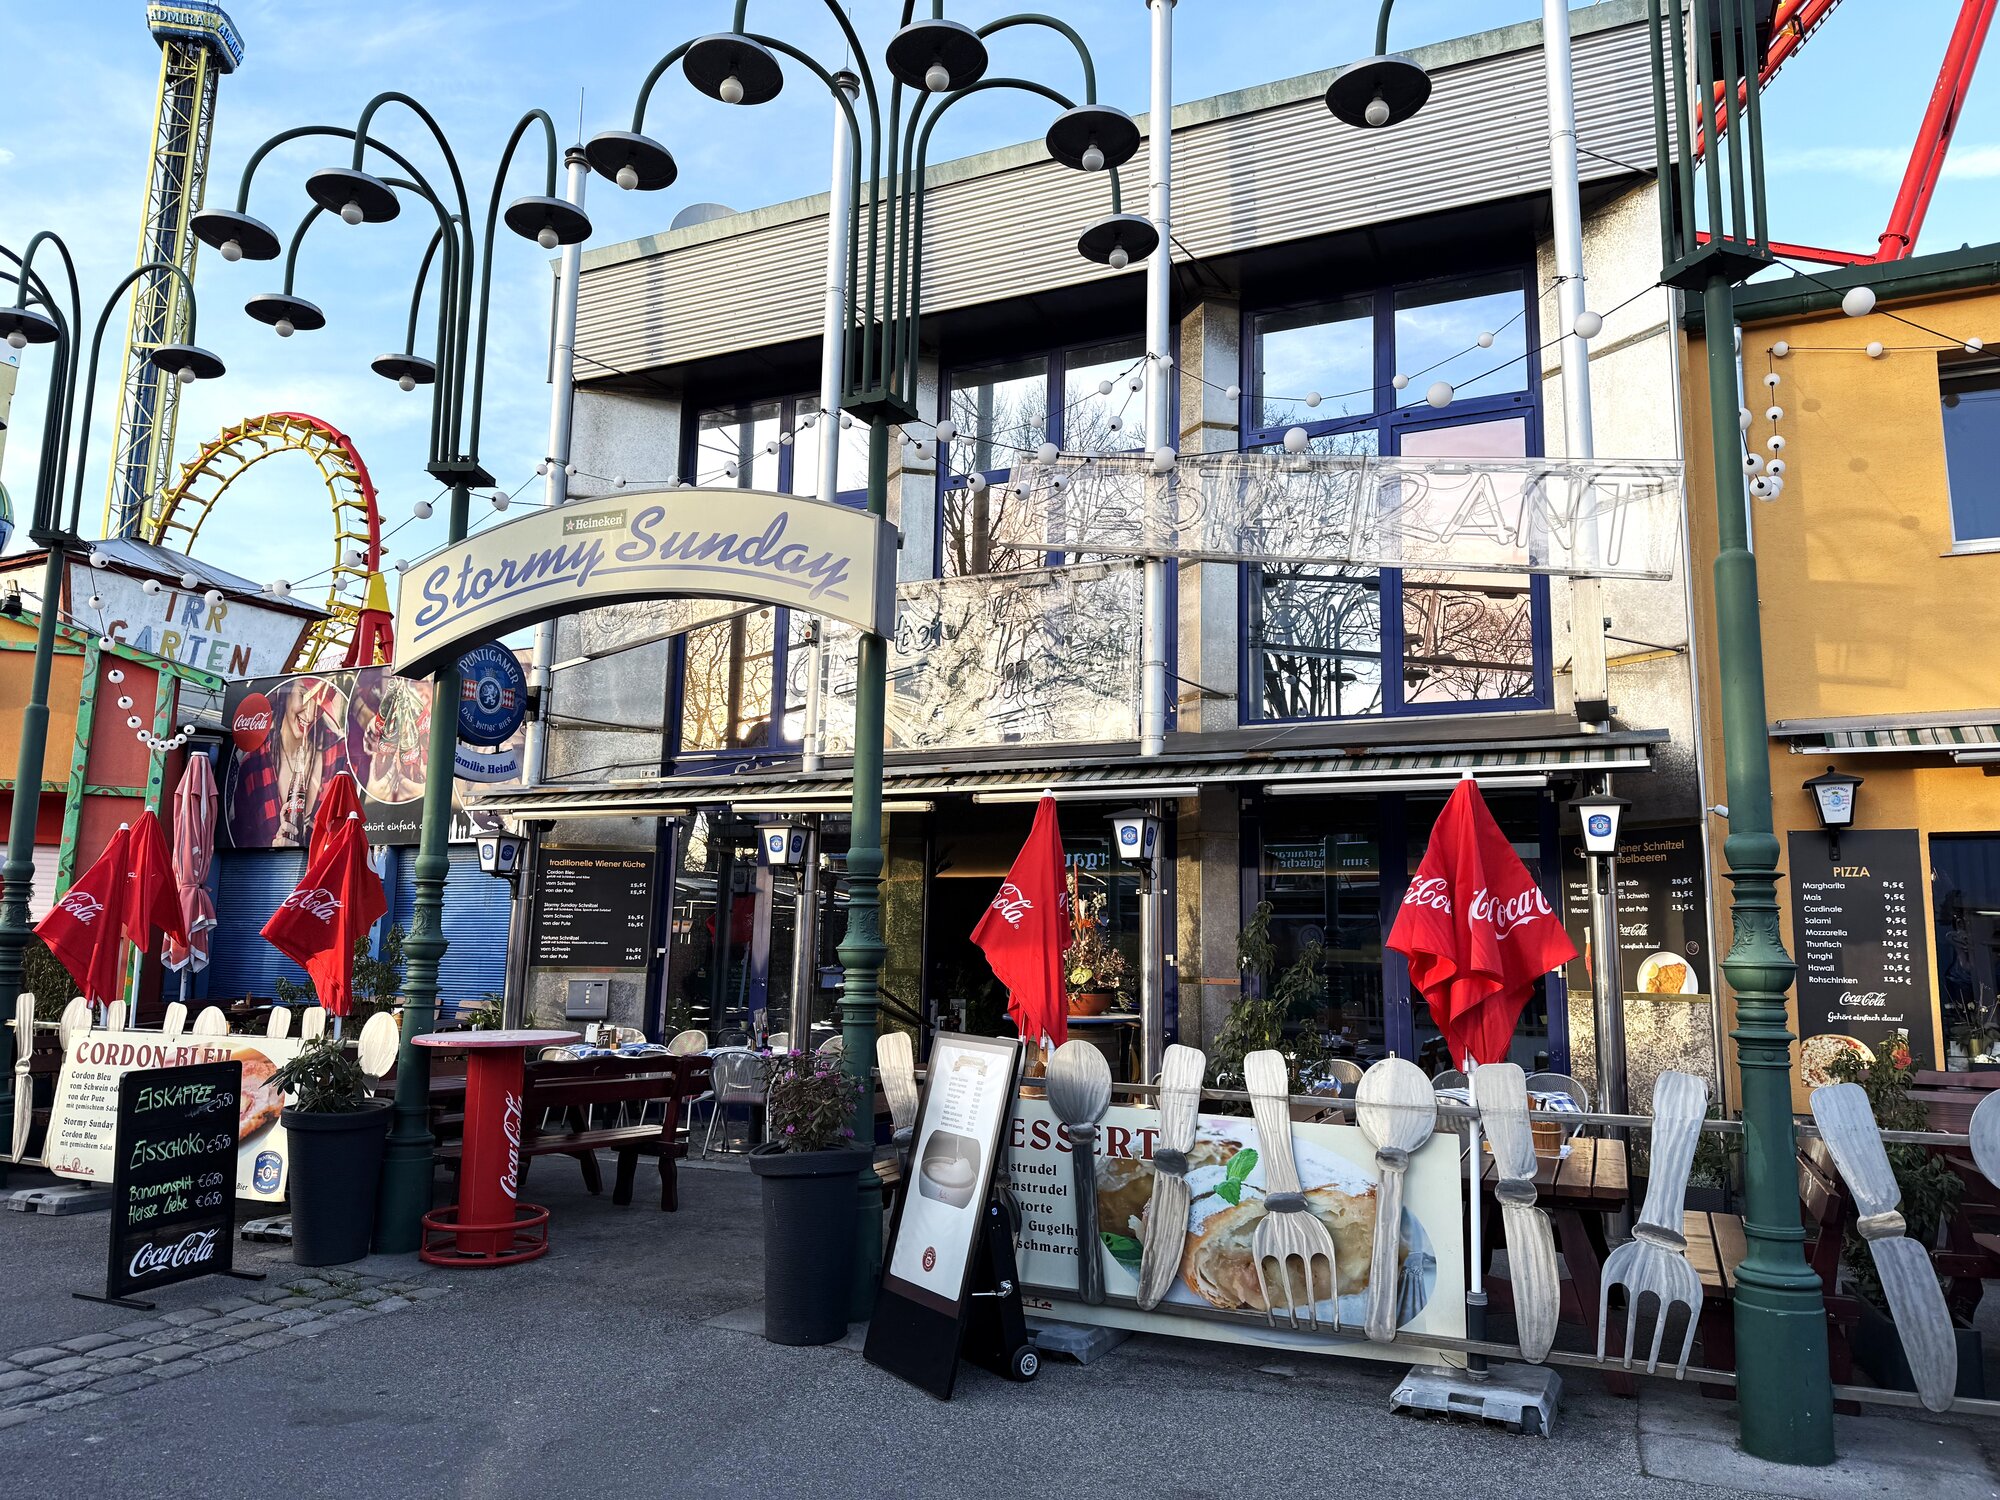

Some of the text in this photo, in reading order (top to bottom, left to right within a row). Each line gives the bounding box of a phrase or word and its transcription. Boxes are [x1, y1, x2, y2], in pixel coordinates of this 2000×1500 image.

[150, 9, 215, 29] ADMIRAL
[217, 23, 244, 67] ADMIRA
[574, 513, 623, 531] Heineken
[414, 505, 850, 626] Stormy Sunday
[165, 591, 227, 633] IRR
[108, 620, 251, 676] GARTEN
[459, 649, 519, 684] PUNTIGAMER
[461, 706, 475, 723] DAS
[499, 716, 512, 730] BIER
[487, 760, 517, 774] Heindl
[362, 822, 384, 831] ehört
[387, 819, 416, 833] einfach
[1618, 840, 1685, 853] iener Schnitzel
[550, 859, 593, 867] traditionelle
[1833, 866, 1871, 877] PIZZA
[1671, 877, 1693, 885] 20,5€
[1882, 881, 1904, 889] 8,5€
[1884, 893, 1905, 901] 9,5€
[1884, 905, 1906, 913] 9,5€
[1885, 917, 1907, 925] 9,5€
[1619, 923, 1650, 936] oca-Cola
[1805, 929, 1908, 937] Mozzarella 9,5€
[1882, 940, 1909, 949] 10,5€
[1807, 952, 1833, 960] Funghi
[1809, 976, 1858, 984] Rohschinken
[1839, 991, 1887, 1006] Coca-Cola
[1827, 1012, 1903, 1022] Gehört einfach dazu!
[76, 1042, 168, 1068] CORDON
[71, 1071, 111, 1081] Cordon Bleu
[83, 1083, 109, 1091] Schwein
[80, 1093, 90, 1101] der
[91, 1094, 105, 1102] Pute
[76, 1103, 105, 1111] gemischtem
[64, 1117, 114, 1130] Stormy Sunday
[61, 1130, 83, 1139] Cordon
[1009, 1118, 1160, 1161] ESSERT
[69, 1141, 99, 1150] gemischtem
[100, 1142, 112, 1150] Salat
[206, 1134, 231, 1153] €5,50
[500, 1090, 522, 1199] Coca-Cola
[1010, 1163, 1057, 1176] strudel
[129, 1175, 195, 1201] Bananensplit
[236, 1182, 248, 1190] Bier
[128, 1203, 158, 1226] Heisse
[163, 1195, 189, 1215] Liebe
[1020, 1201, 1053, 1214] torte
[129, 1228, 220, 1277] Coca-Cola
[1017, 1239, 1079, 1256] schmarre
